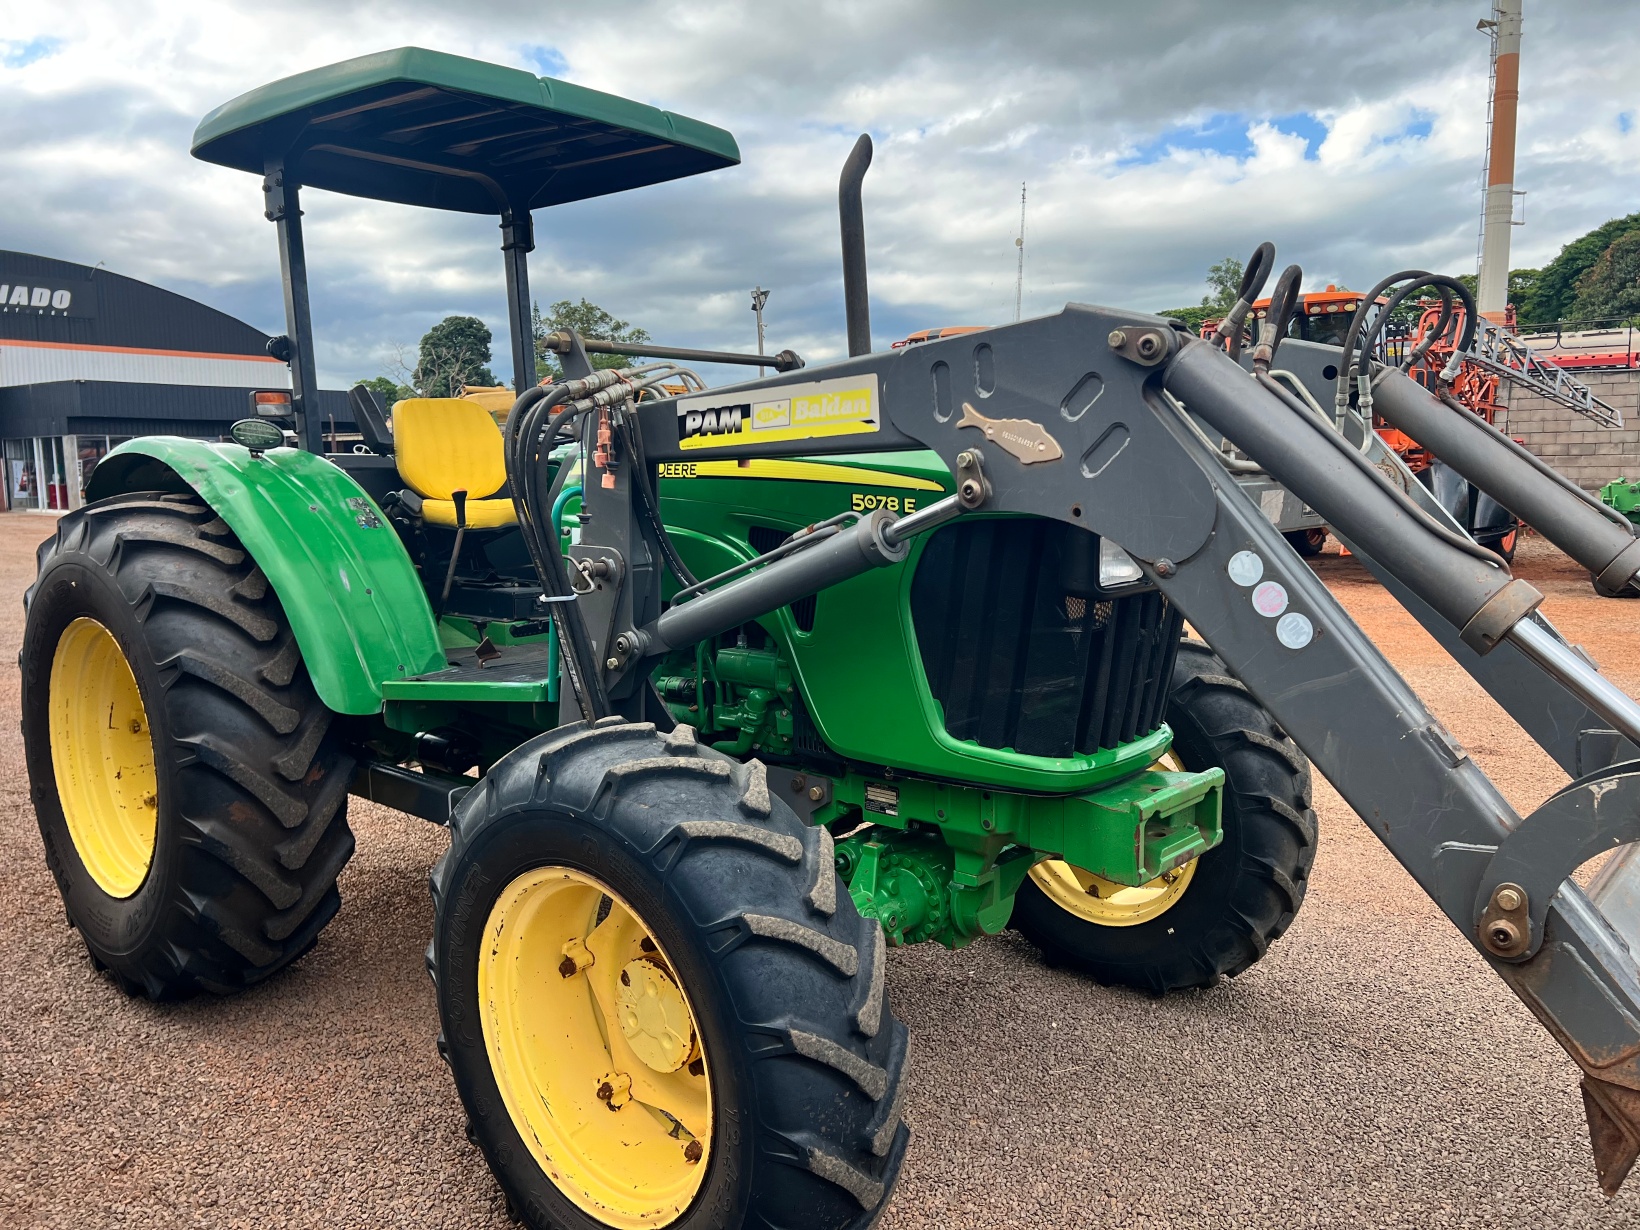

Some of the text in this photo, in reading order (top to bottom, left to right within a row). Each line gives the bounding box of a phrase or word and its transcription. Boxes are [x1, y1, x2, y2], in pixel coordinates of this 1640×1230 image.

[794, 396, 868, 421] Baldan
[685, 404, 743, 438] PAM
[659, 463, 697, 477] DEERE
[852, 493, 916, 513] 5078 E
